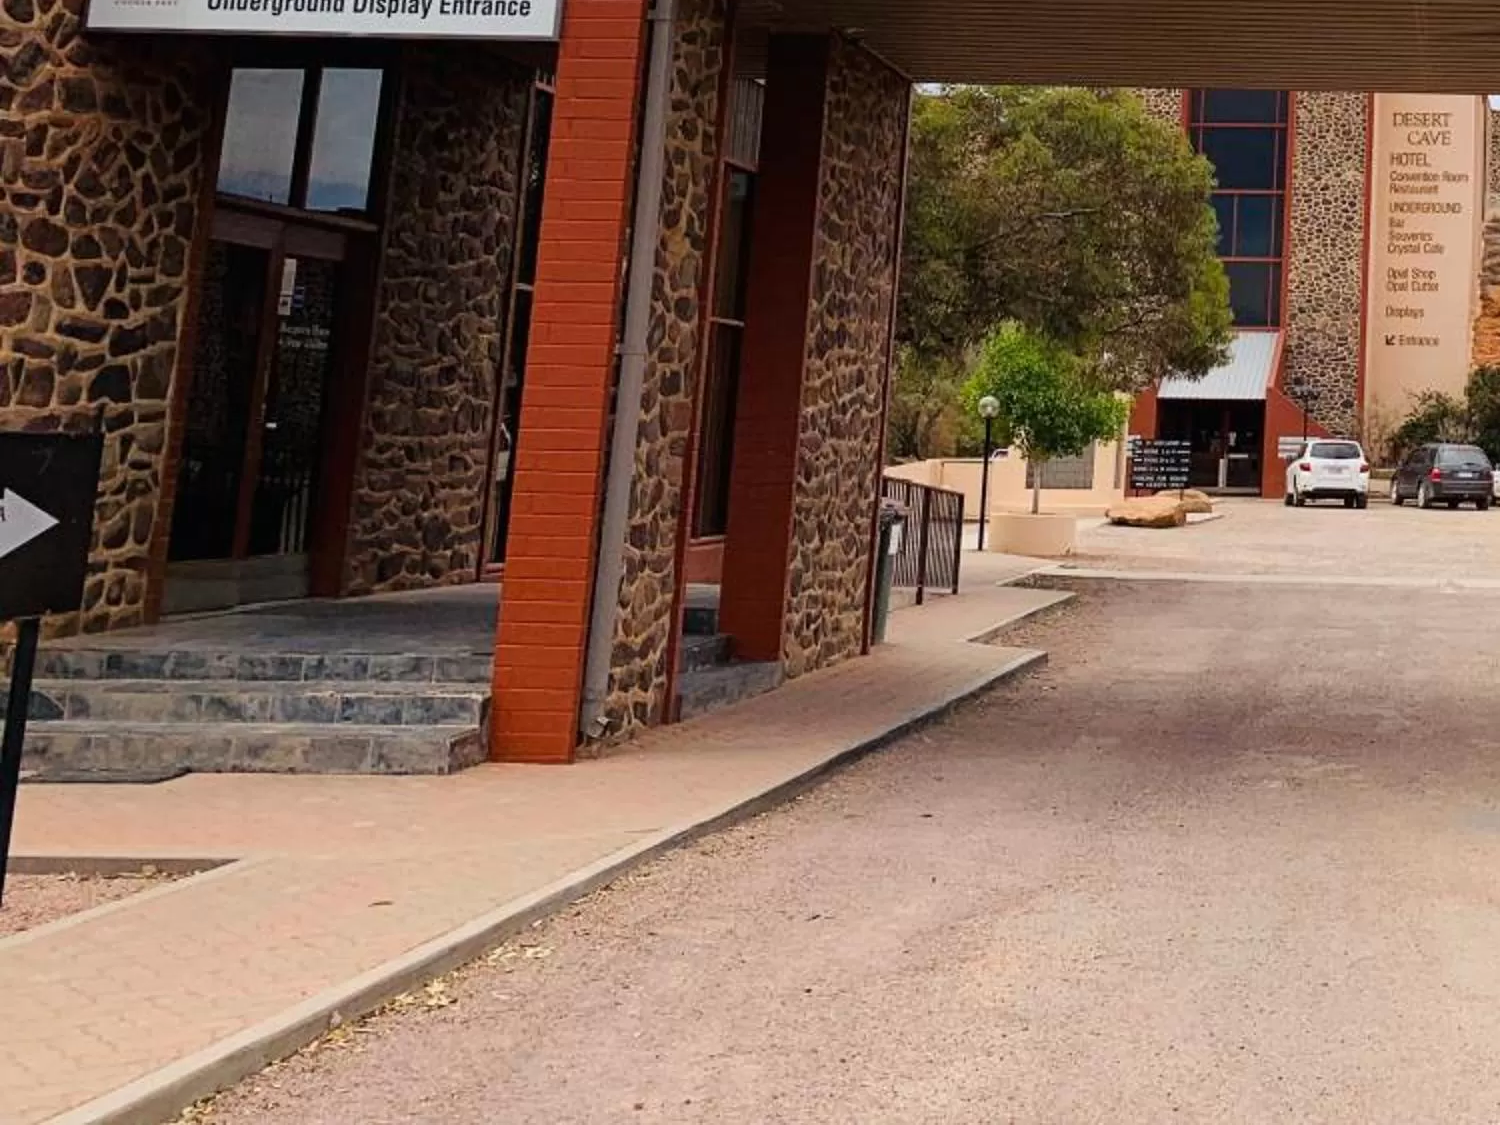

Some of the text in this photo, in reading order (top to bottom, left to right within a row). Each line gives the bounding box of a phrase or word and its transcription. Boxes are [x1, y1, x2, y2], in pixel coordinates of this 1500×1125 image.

[1392, 112, 1453, 128] DESERT
[1407, 130, 1452, 146] CAVE
[1389, 152, 1432, 167] HOTEL
[1389, 202, 1463, 214] UNDERGROUND
[1387, 242, 1420, 256] Crystal
[1387, 267, 1437, 280] Opal Shop
[1386, 280, 1440, 293] Opal Cutter
[1385, 306, 1424, 319] Displays
[1399, 335, 1440, 347] Entrance
